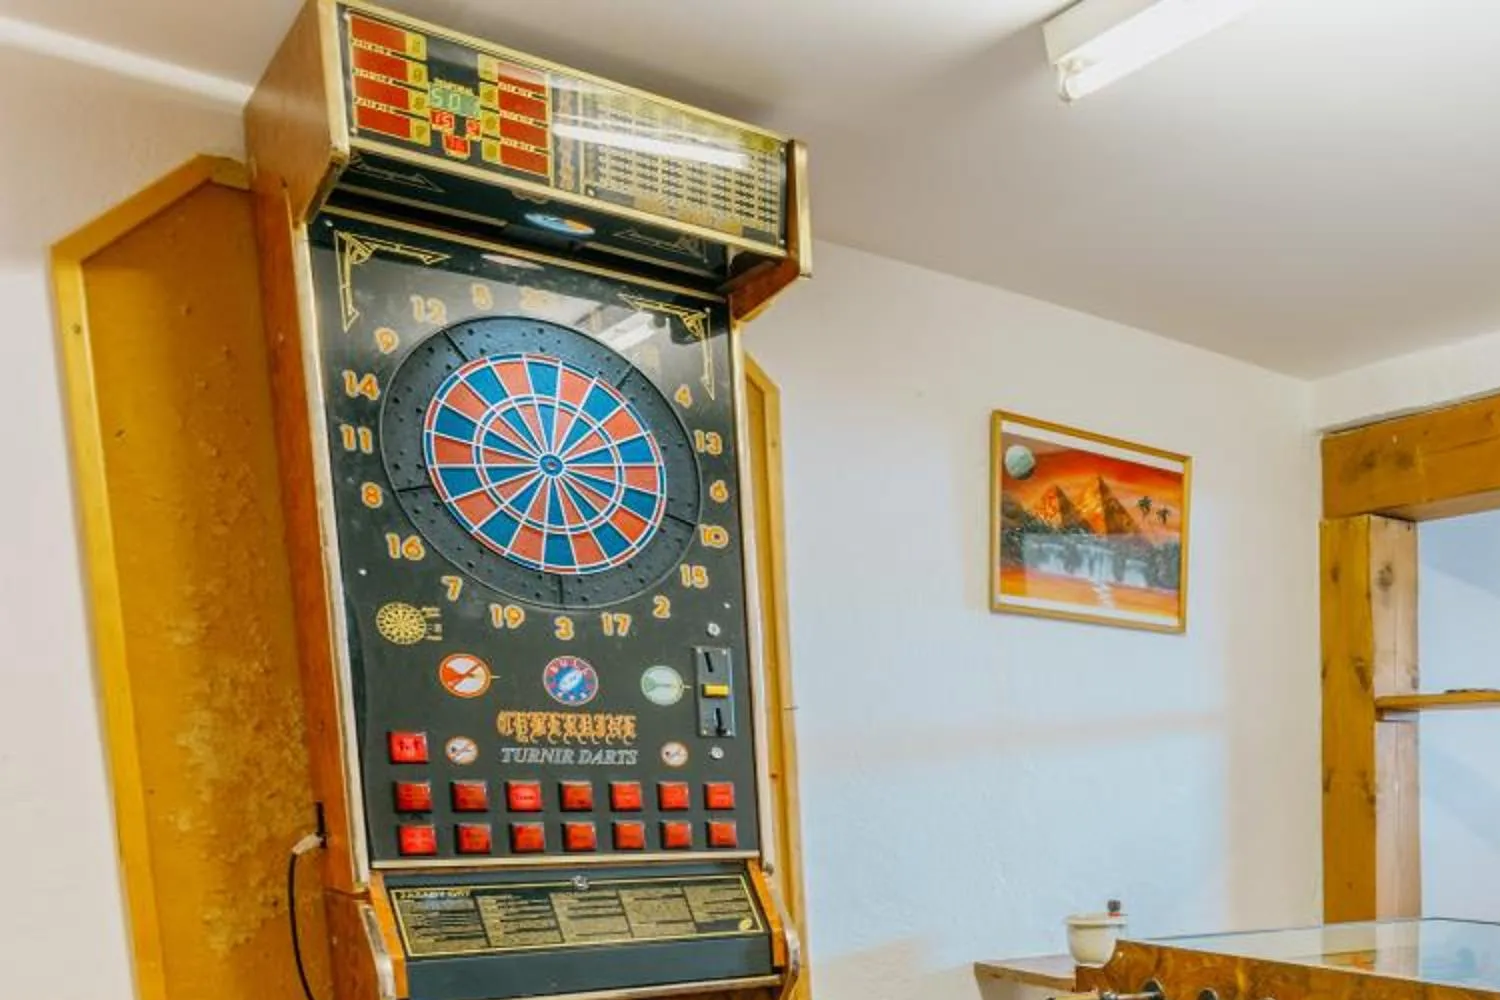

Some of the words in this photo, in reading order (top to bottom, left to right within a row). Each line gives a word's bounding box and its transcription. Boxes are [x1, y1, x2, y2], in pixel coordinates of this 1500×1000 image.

[342, 369, 381, 401] 14
[340, 424, 373, 455] 11
[361, 477, 383, 508] 8
[709, 480, 729, 503] 6
[385, 532, 426, 561] 16
[698, 524, 729, 548] 10
[441, 576, 463, 601] 7
[489, 604, 526, 629] 19
[652, 595, 671, 619] 2
[554, 616, 575, 641] 3
[601, 612, 631, 637] 17
[501, 747, 574, 765] TURNIR
[577, 749, 638, 765] DARTS
